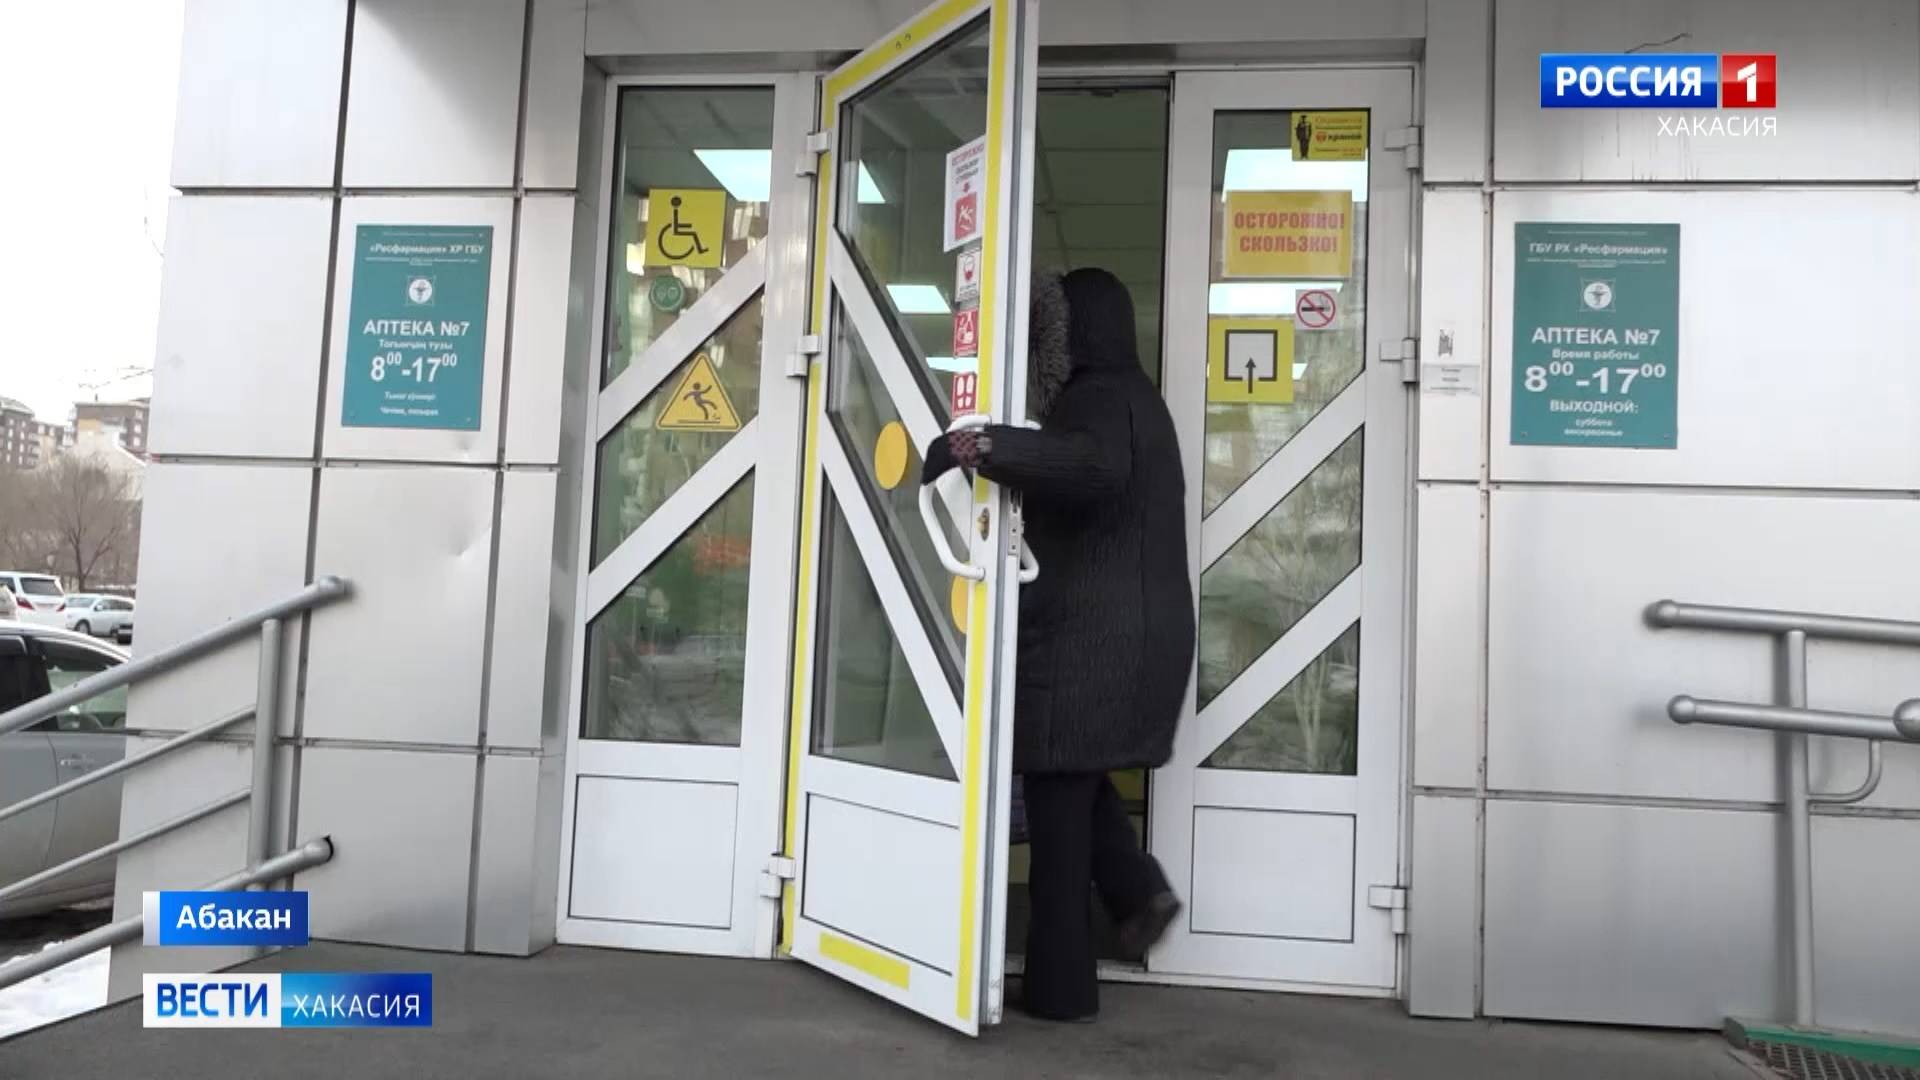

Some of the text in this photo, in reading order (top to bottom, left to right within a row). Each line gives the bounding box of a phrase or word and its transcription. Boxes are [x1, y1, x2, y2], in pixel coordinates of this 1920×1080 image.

[1234, 212, 1345, 229] ОСТОРОЖНО!
[465, 245, 484, 254] ГБУ
[1240, 235, 1337, 253] СКОЛЬЗКО!
[1529, 243, 1551, 254] ГБУ
[1555, 243, 1570, 254] РХ
[363, 320, 470, 336] АПТЕКА №7
[1532, 327, 1661, 346] АПТЕКА №7
[1552, 349, 1591, 361] Время
[1550, 399, 1639, 414] ВЫХОДНОЙ:
